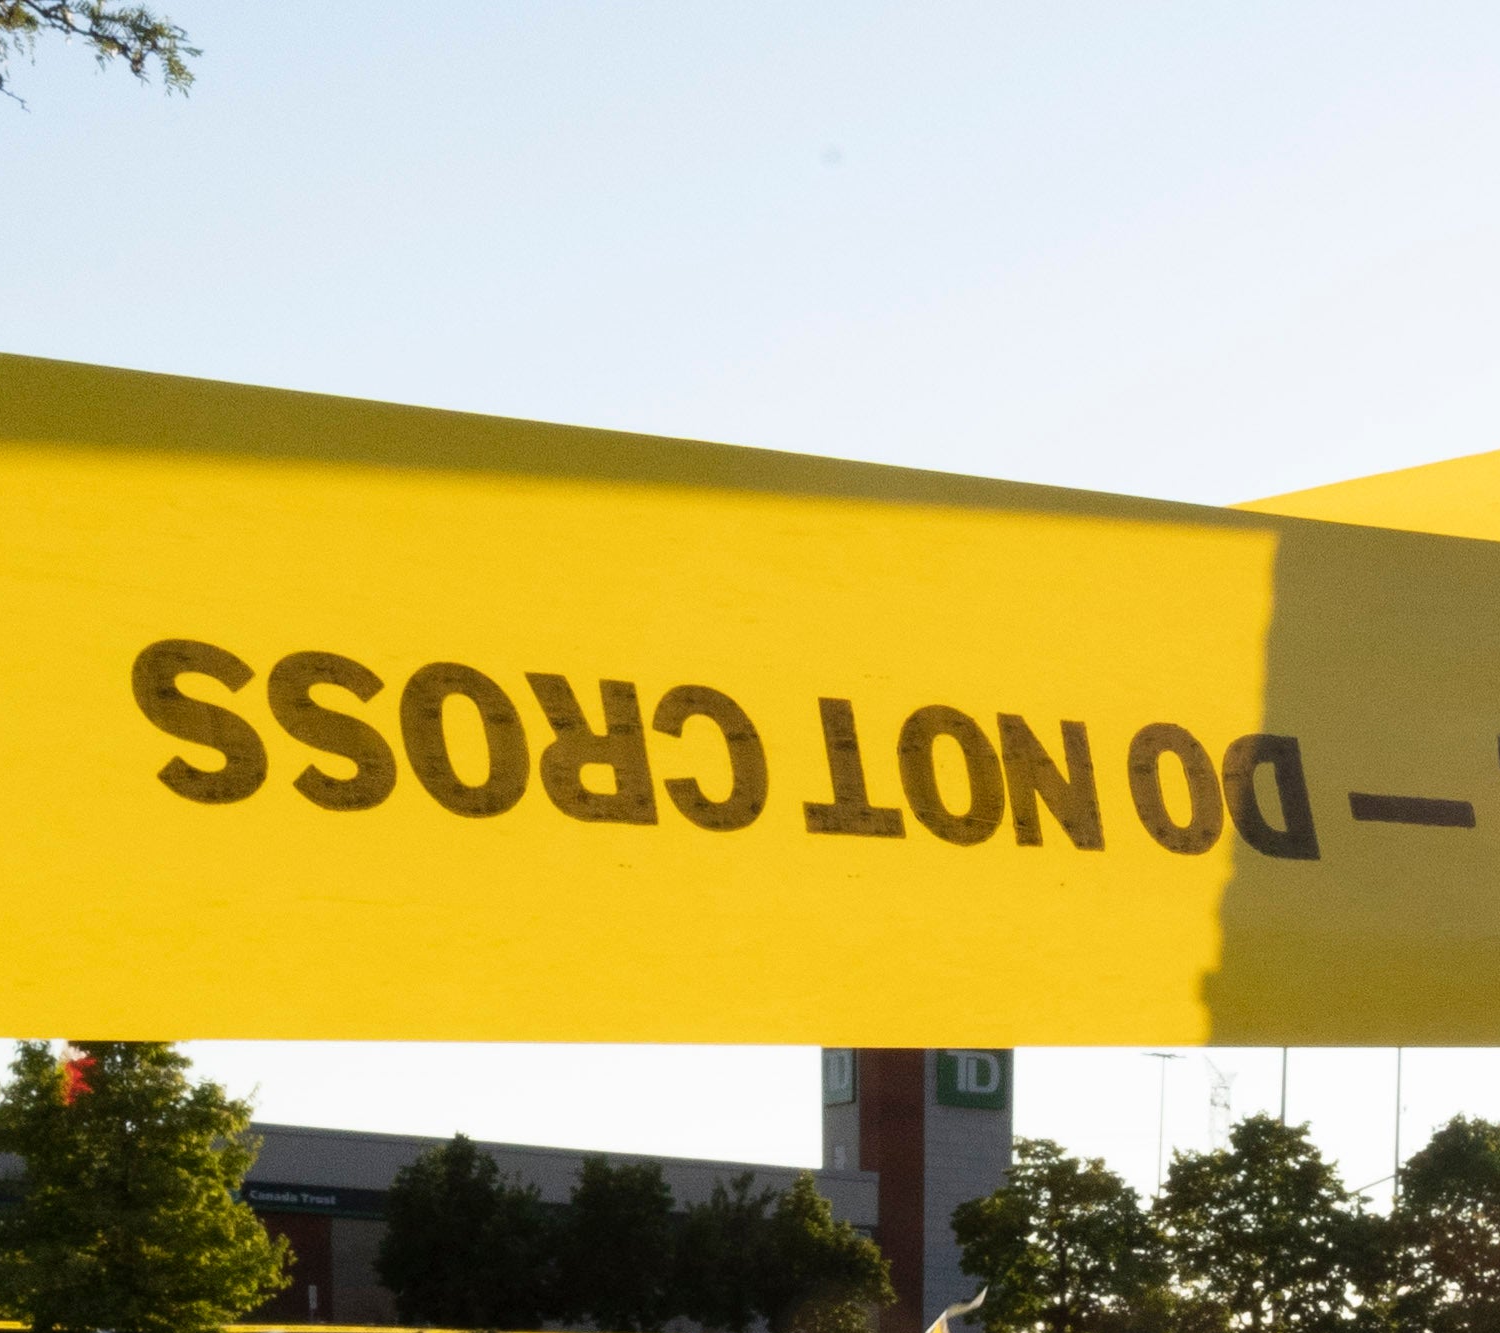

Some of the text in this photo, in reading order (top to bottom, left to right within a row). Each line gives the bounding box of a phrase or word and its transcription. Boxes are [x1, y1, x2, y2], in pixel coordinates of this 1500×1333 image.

[131, 637, 770, 833] CROSS
[802, 695, 1107, 853] NOT
[1127, 721, 1322, 861] DO
[946, 1050, 1000, 1094] TD
